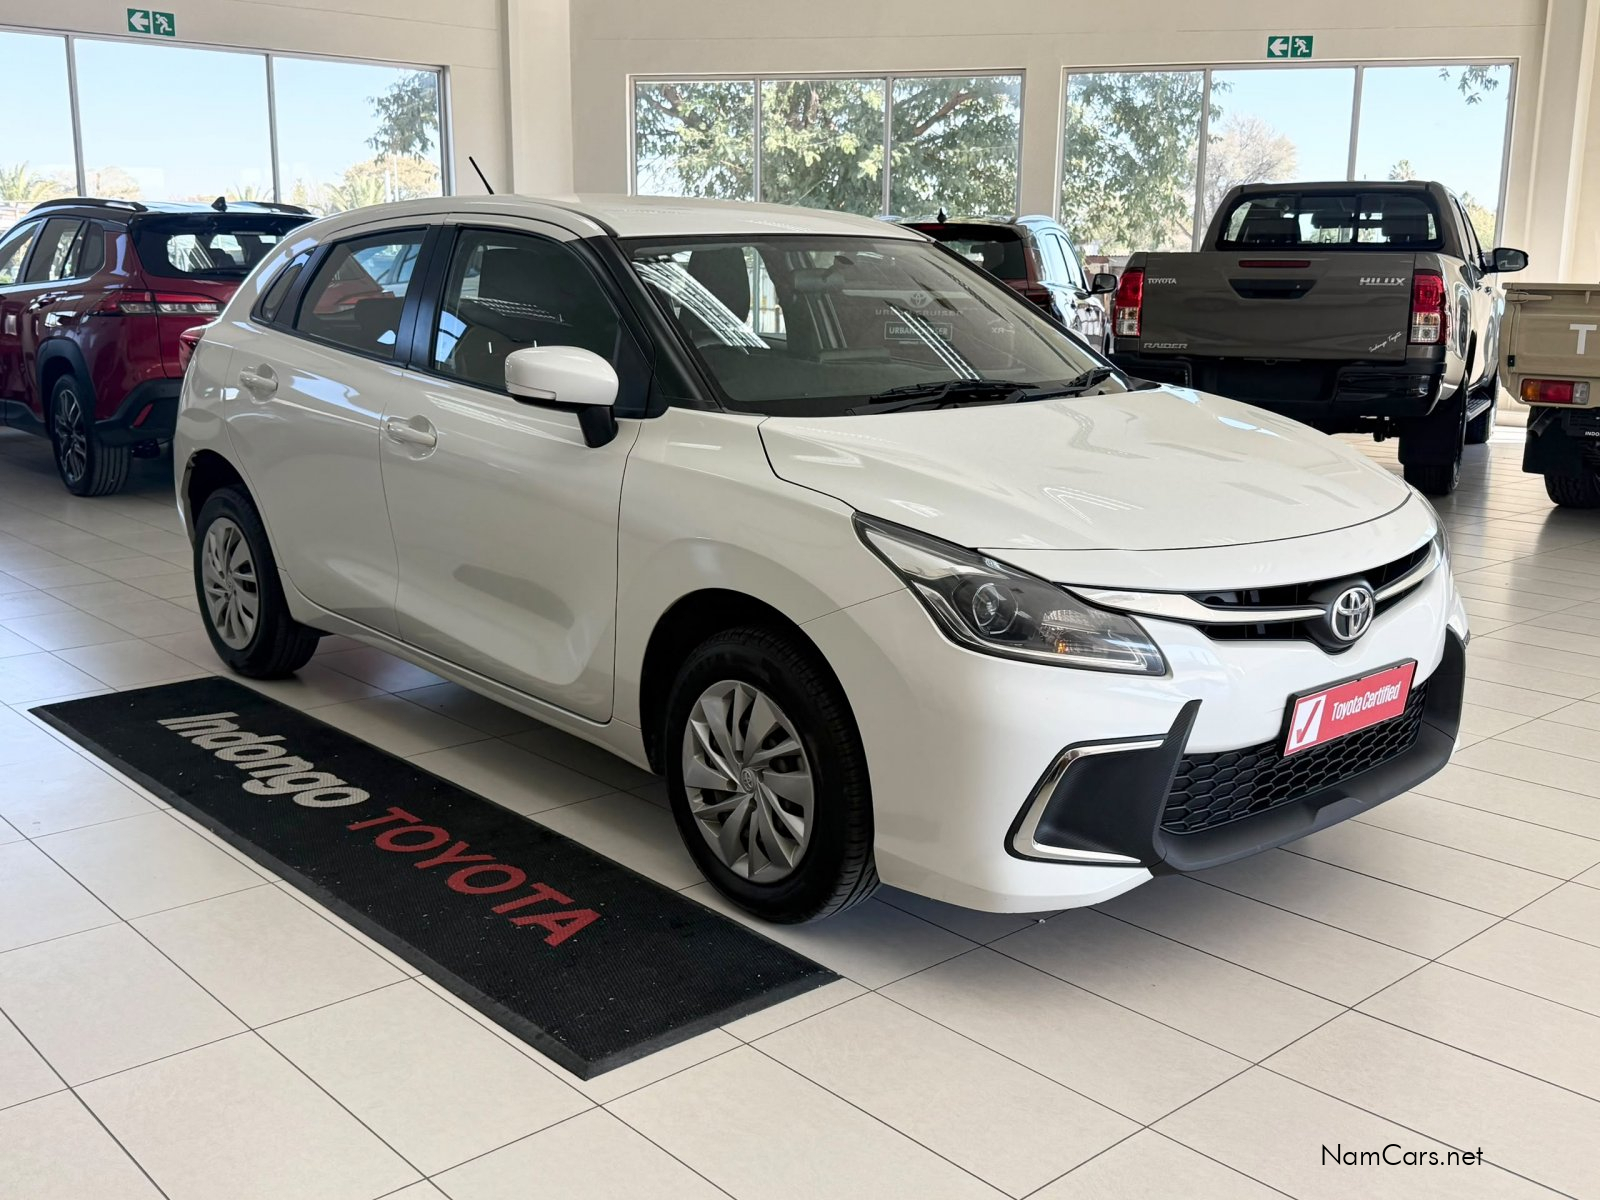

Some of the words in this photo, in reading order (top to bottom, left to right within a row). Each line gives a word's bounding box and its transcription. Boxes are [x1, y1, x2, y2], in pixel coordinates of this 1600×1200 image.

[1147, 277, 1177, 285] TOYOTA
[1360, 277, 1406, 286] HILUX
[1332, 696, 1362, 721] Toyota
[1361, 681, 1402, 711] Certified
[157, 711, 370, 808] Indongo
[346, 806, 601, 947] TOYOTA
